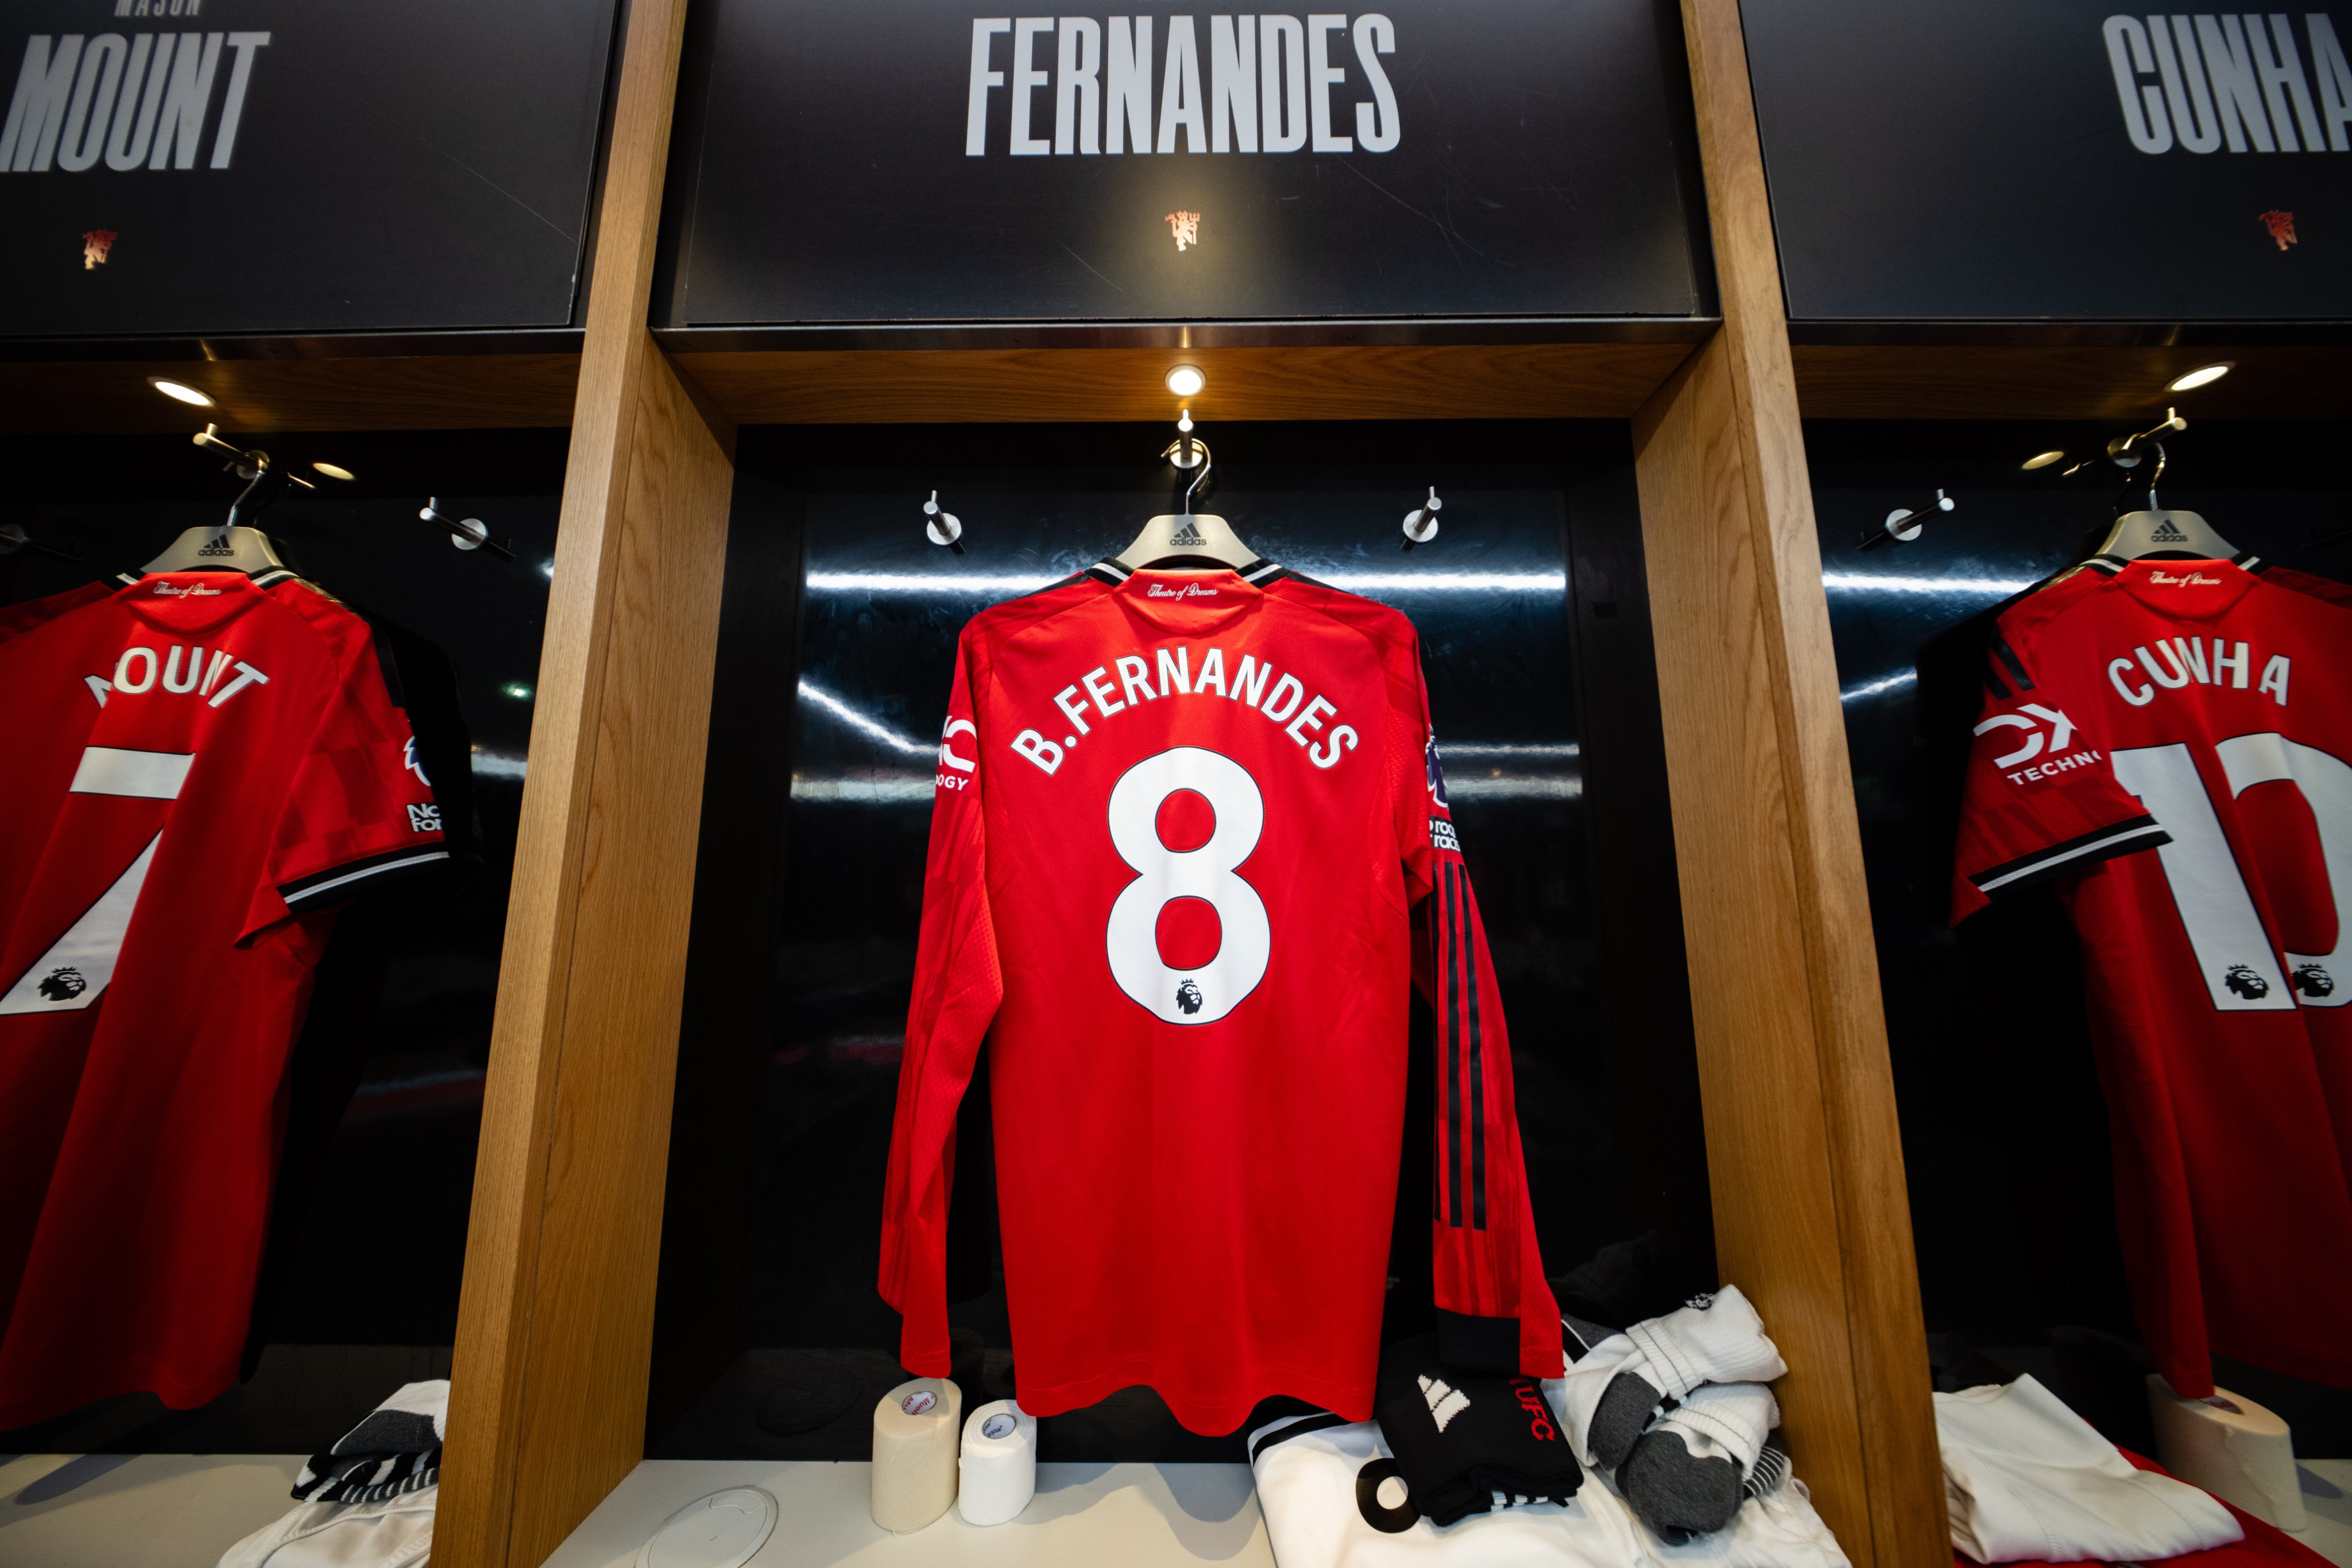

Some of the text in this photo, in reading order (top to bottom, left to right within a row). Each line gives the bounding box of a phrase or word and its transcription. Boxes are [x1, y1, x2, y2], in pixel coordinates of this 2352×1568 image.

[0, 31, 271, 172] MOUNT
[966, 13, 1401, 156] FERNANDES
[2103, 13, 2352, 154] CUNHA
[198, 547, 234, 556] adidas
[1147, 582, 1218, 601] Theatre of Dreams
[1170, 537, 1207, 546] adidas
[1010, 646, 1359, 776] B.FERNANDES
[2108, 636, 2291, 707] CUNHA
[1106, 746, 1271, 1026] 8
